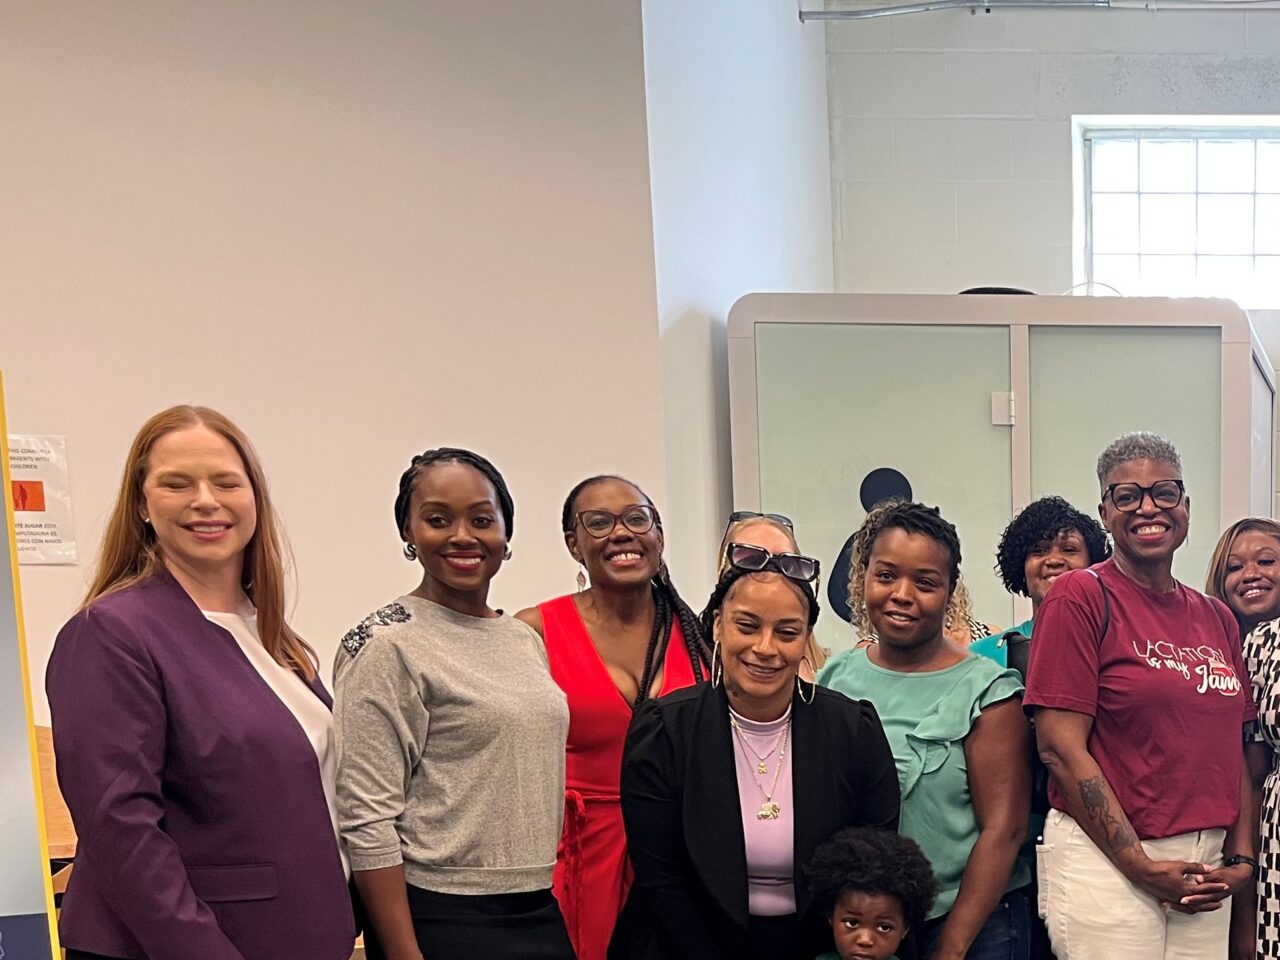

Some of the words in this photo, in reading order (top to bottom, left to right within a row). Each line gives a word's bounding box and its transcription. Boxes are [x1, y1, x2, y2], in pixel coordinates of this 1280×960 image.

[1145, 657, 1162, 669] is
[1164, 659, 1191, 680] my
[1194, 664, 1241, 694] Jam
